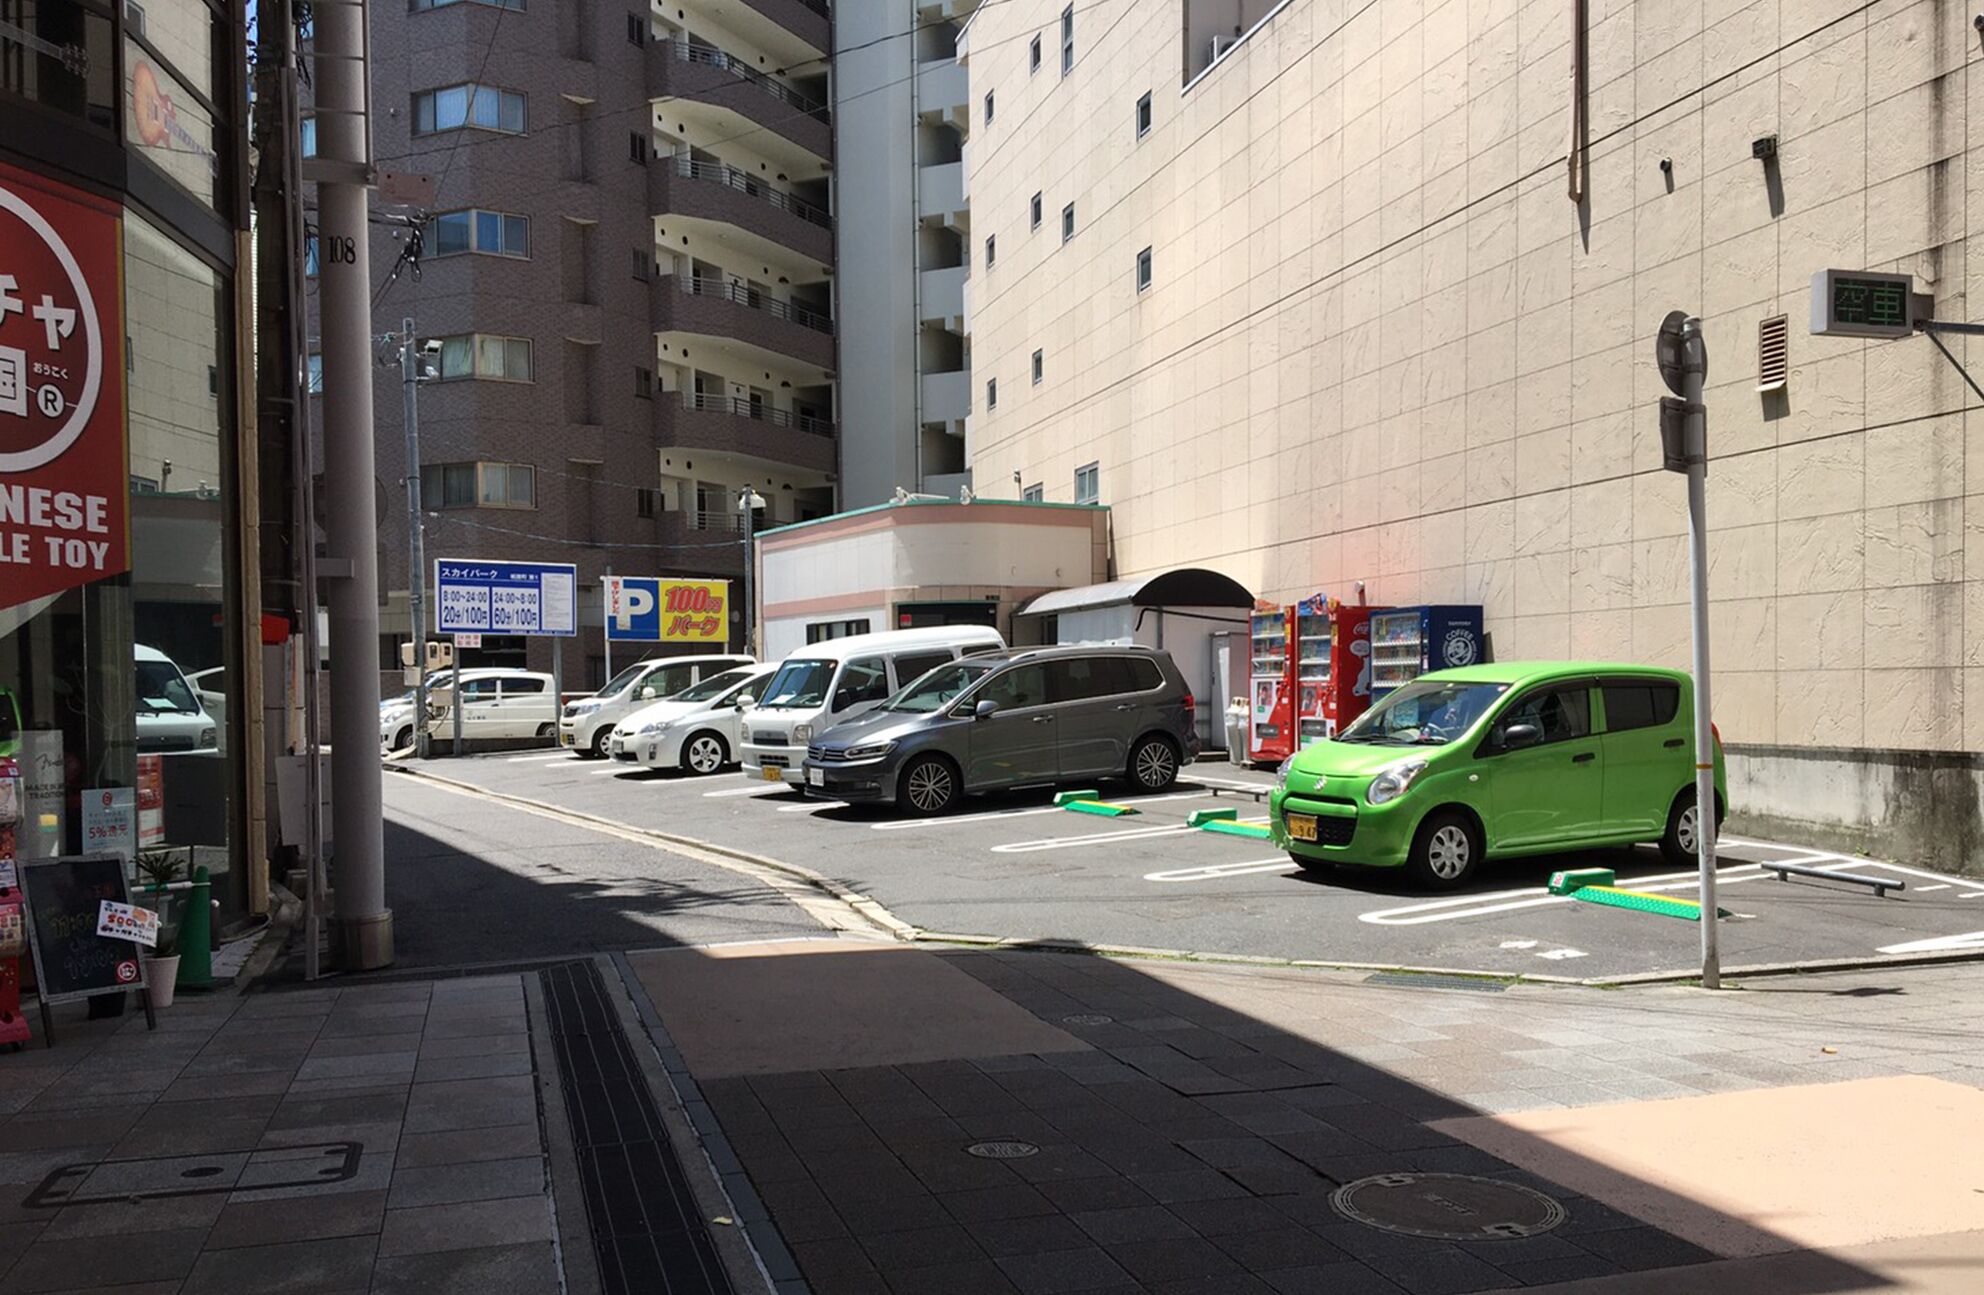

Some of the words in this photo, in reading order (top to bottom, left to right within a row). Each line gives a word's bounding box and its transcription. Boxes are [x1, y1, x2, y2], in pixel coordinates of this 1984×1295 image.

[328, 235, 356, 264] 108
[1836, 282, 1904, 325] 空車
[32, 361, 69, 380] おうこく
[0, 483, 108, 533] NESE
[0, 531, 31, 564] LE
[44, 535, 109, 570] TOY
[441, 567, 498, 580] スカイパーク
[616, 587, 654, 630] P
[665, 585, 724, 614] 100円
[443, 606, 488, 625] 20分/100円
[494, 607, 537, 626] 60分/100円
[666, 614, 721, 637] パーク
[1445, 628, 1474, 641] COFFEE
